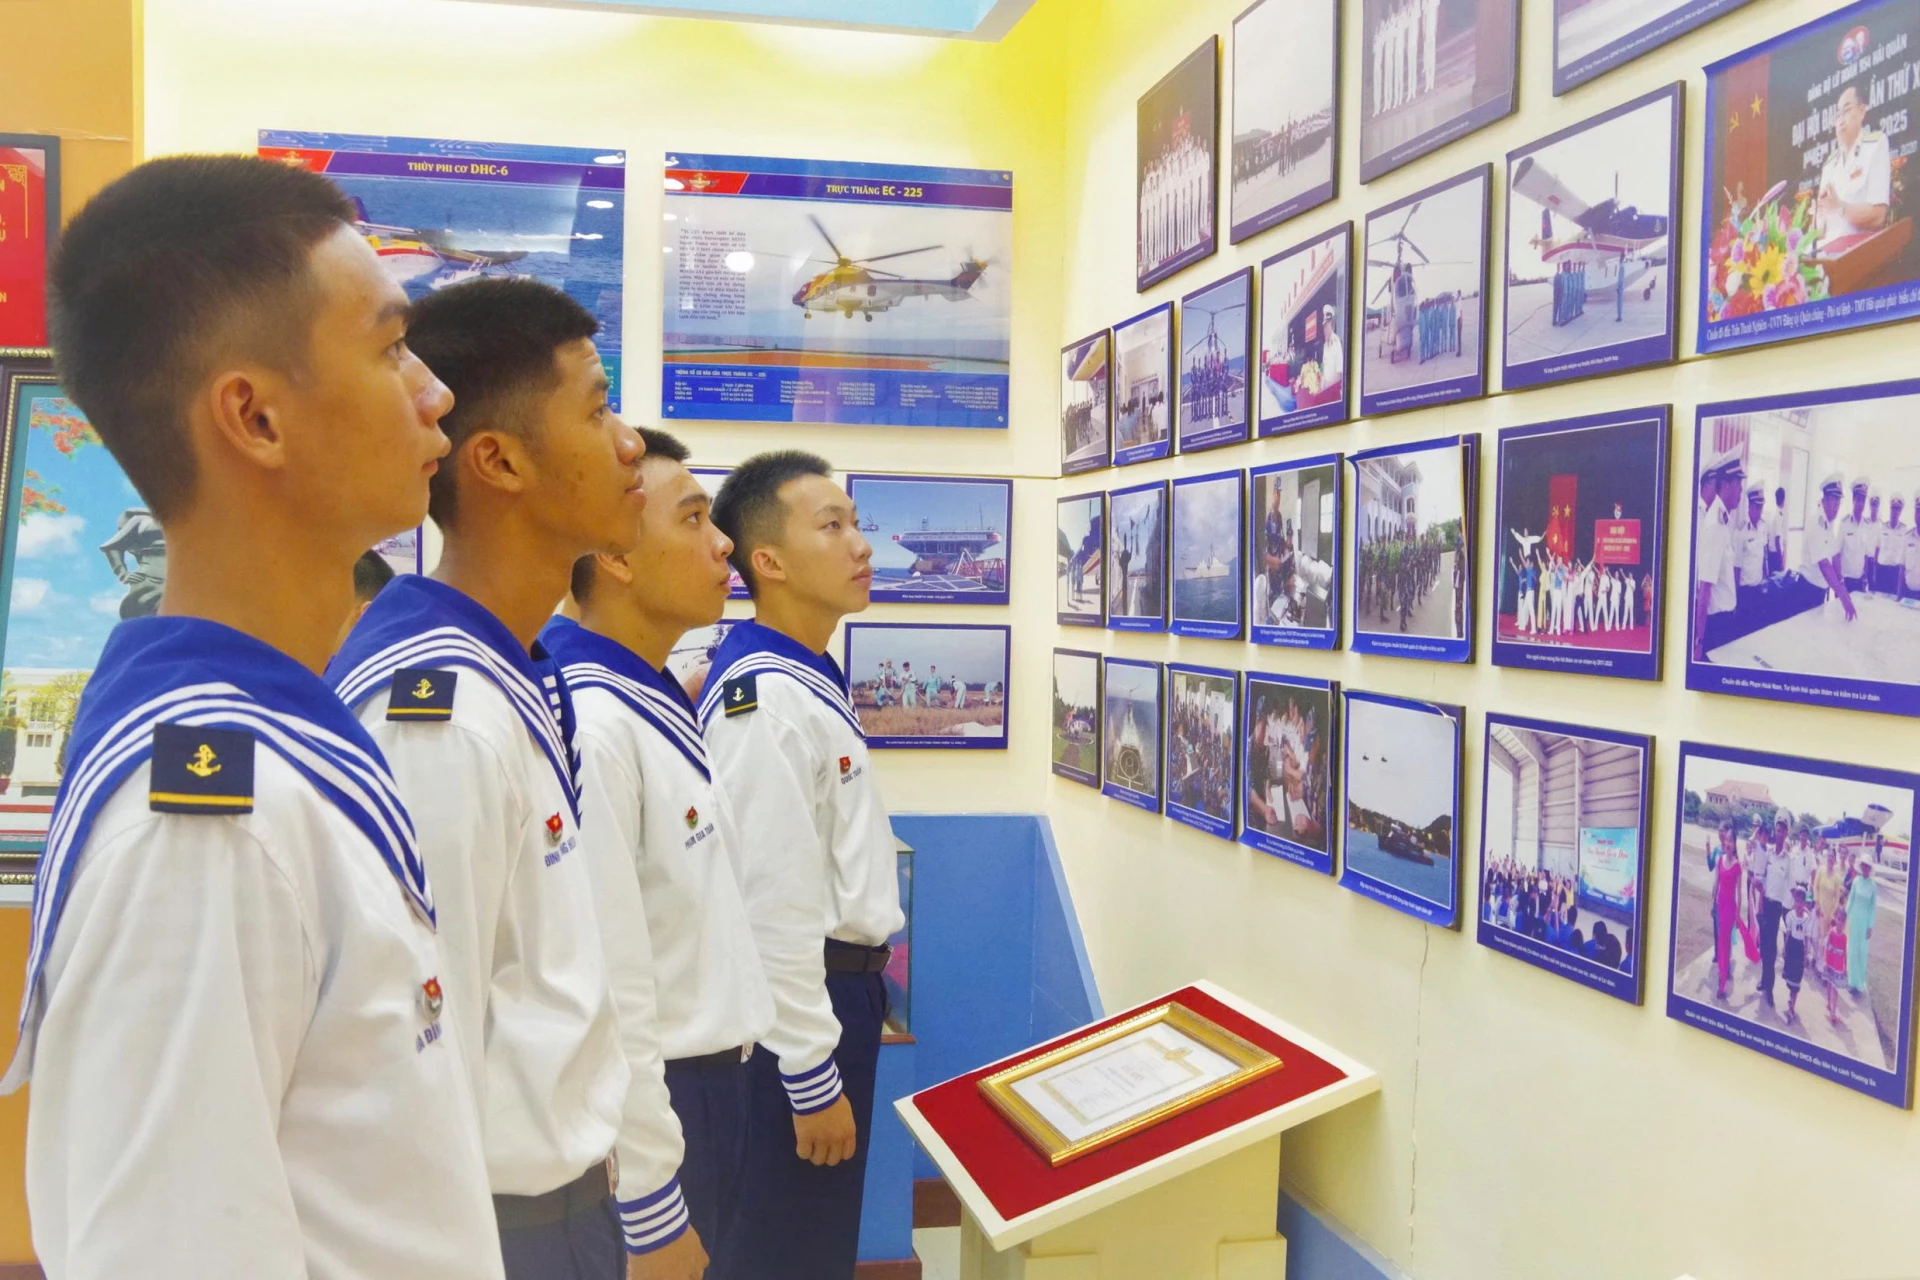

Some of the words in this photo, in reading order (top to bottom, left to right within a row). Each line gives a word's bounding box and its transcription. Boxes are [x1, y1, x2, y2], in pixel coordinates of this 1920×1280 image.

[1792, 120, 1806, 148] ĐẠI
[1806, 108, 1820, 140] HỘI
[1888, 60, 1910, 100] THỨ
[1880, 108, 1908, 137] 2025
[436, 164, 452, 172] PHI
[454, 165, 468, 174] CƠ
[470, 164, 509, 176] DHC-6
[826, 184, 850, 194] TRỰC
[882, 186, 896, 196] EC
[903, 187, 923, 197] 225
